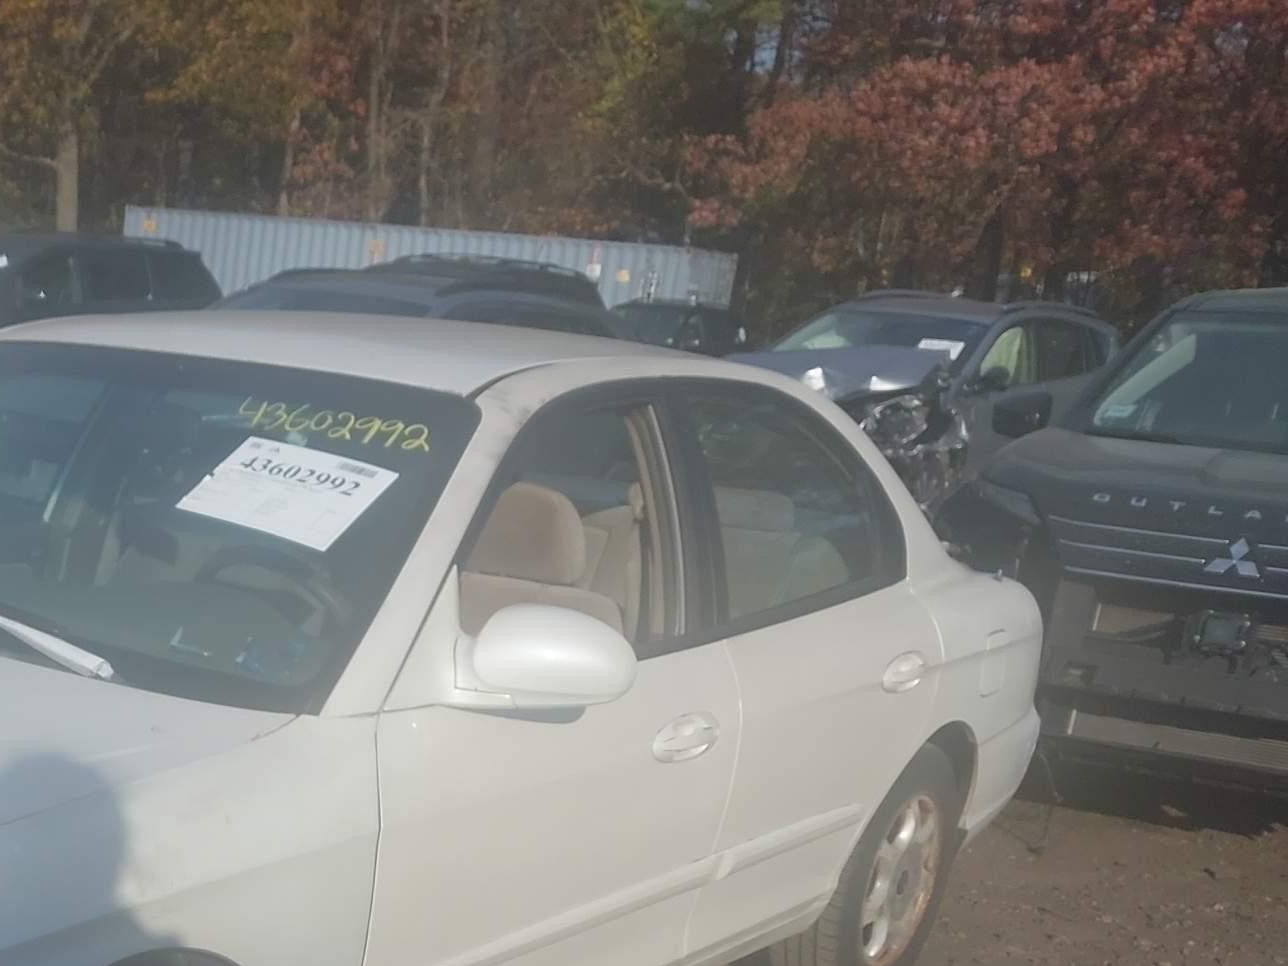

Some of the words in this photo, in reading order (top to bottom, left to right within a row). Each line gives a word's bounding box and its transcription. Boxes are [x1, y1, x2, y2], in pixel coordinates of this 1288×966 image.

[239, 396, 430, 452] 43602992
[241, 456, 361, 496] 43602992
[1092, 493, 1288, 523] OUTLA
